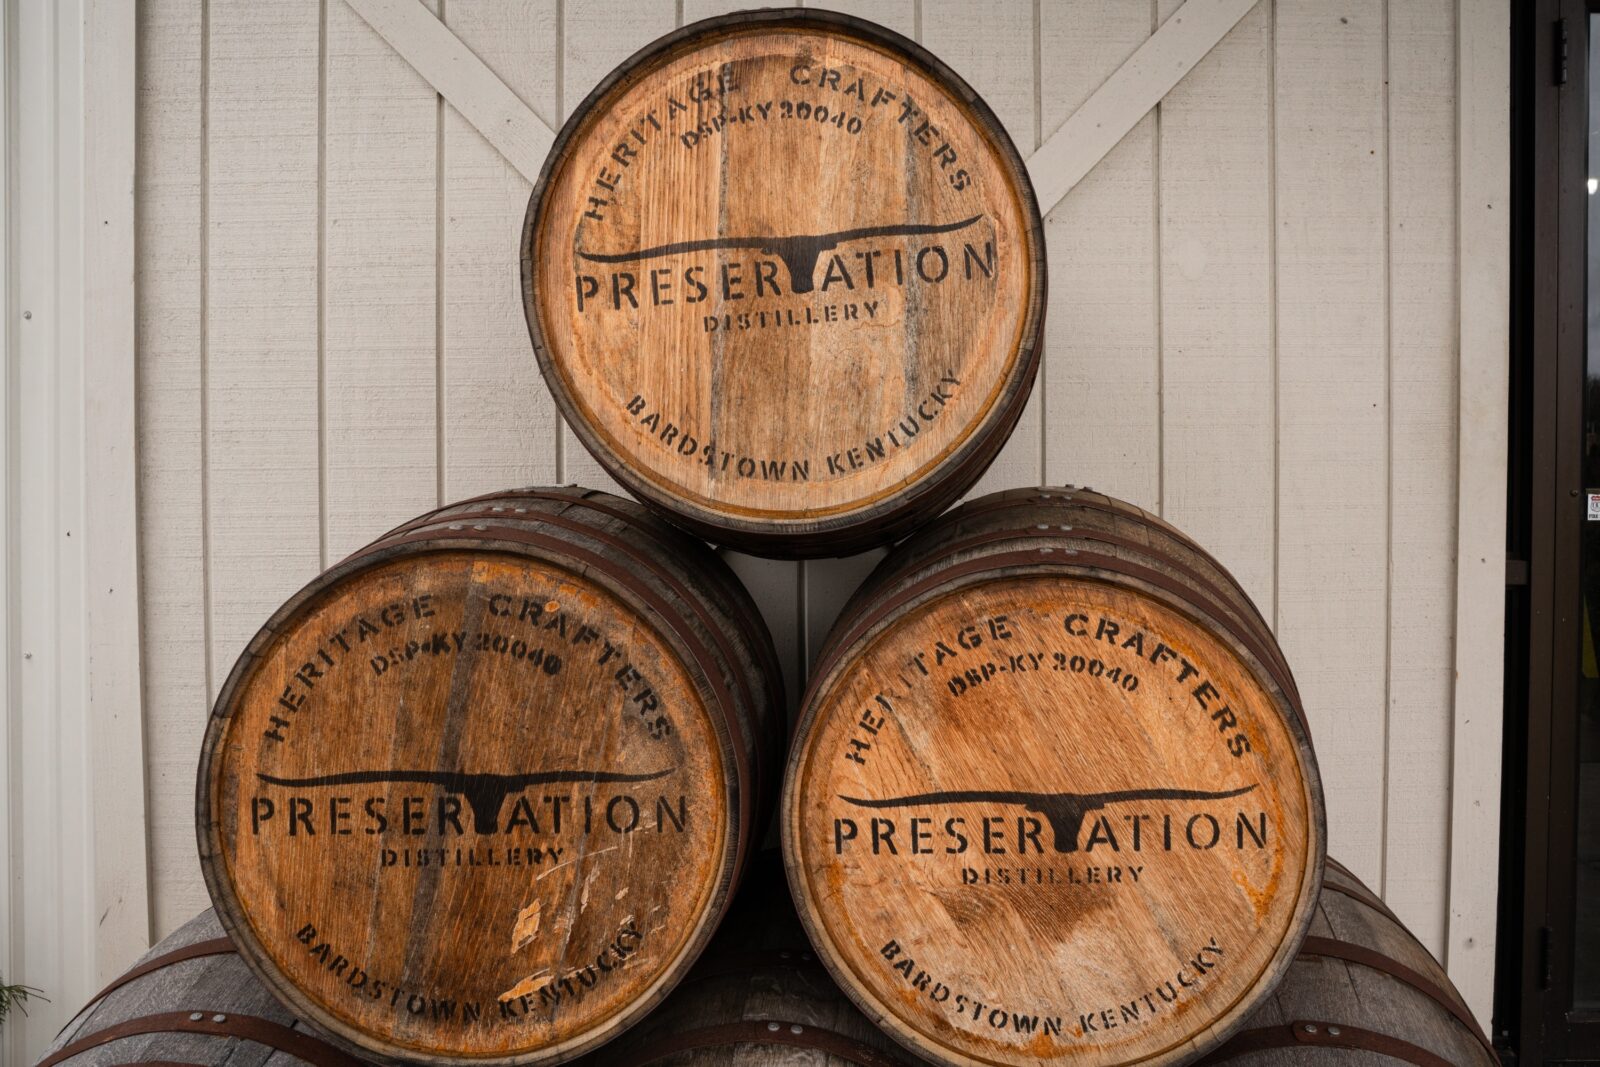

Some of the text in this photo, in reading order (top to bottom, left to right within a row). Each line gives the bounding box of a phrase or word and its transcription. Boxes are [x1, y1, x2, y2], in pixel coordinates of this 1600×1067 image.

[584, 63, 972, 221] HERITAGE CRAFTERS
[780, 101, 863, 136] 20040
[703, 301, 880, 333] DISTILLERY
[626, 369, 962, 482] BARDSTOWN KENTUCKY
[263, 594, 670, 743] HERITAGE CRAFTERS
[1064, 613, 1252, 760] CRAFTERS
[380, 847, 565, 868] DISTILLERY
[962, 865, 1145, 886] DISTILLERY
[296, 920, 645, 1022] BARDSTOWN KENTUCKY
[880, 937, 1224, 1036] BARDSTOWN KENTUCKY
